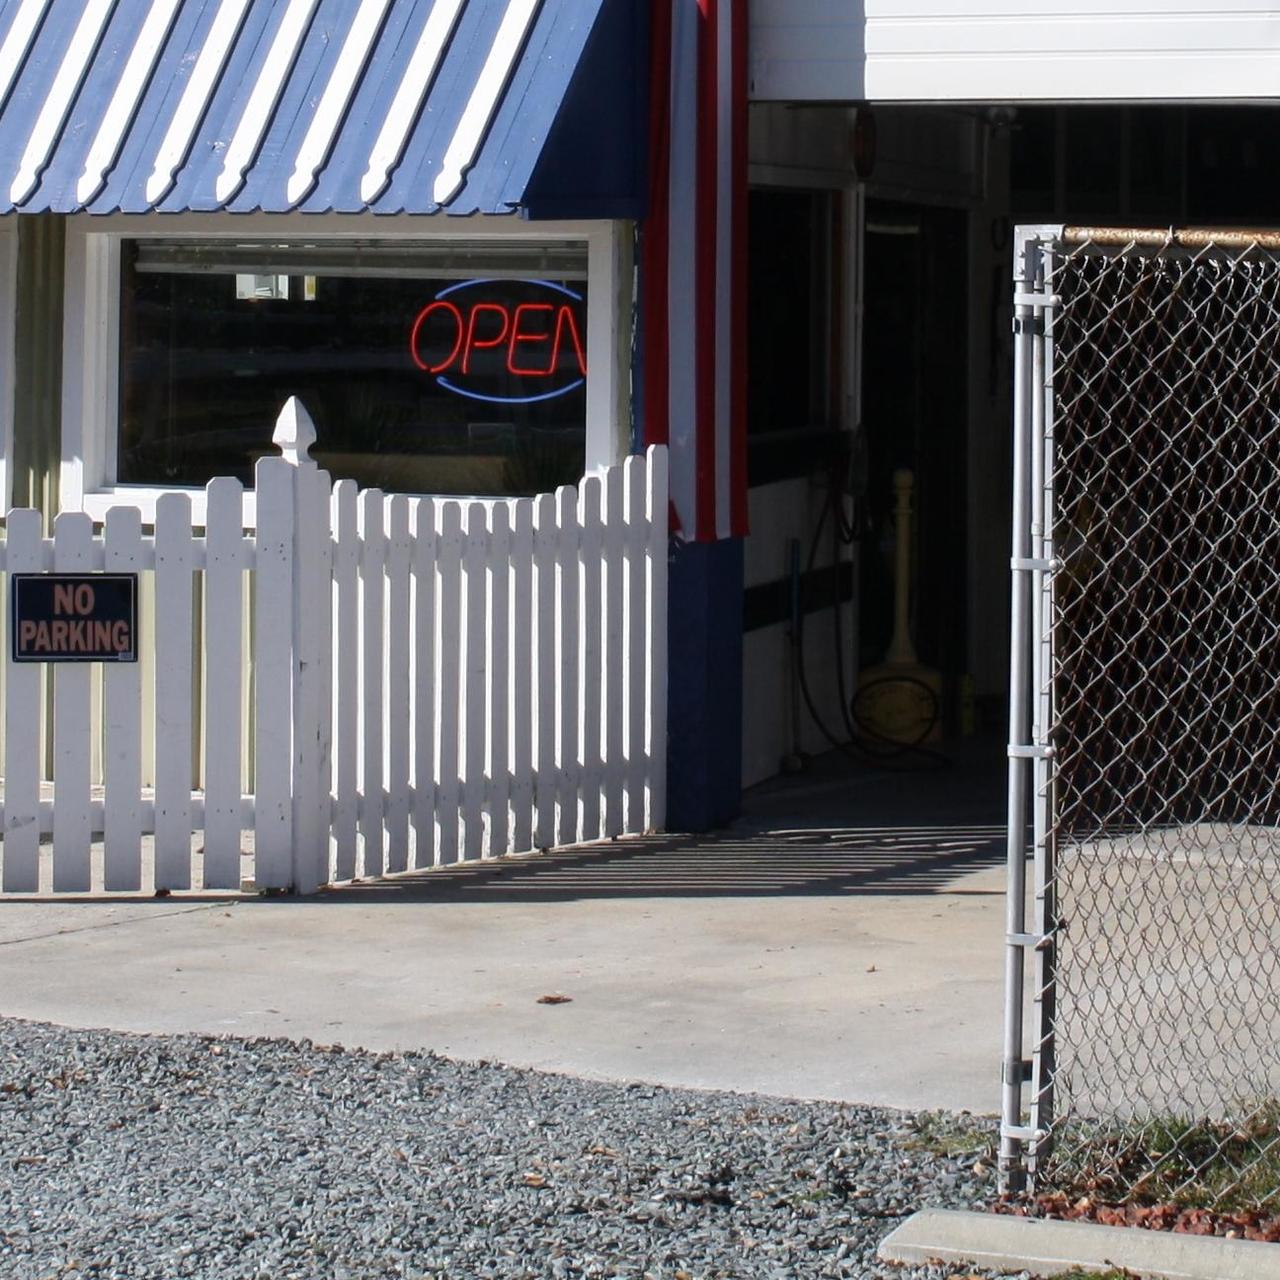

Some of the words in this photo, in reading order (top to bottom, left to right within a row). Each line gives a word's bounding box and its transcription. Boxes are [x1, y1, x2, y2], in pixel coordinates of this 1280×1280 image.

[411, 300, 587, 376] OPEN
[54, 583, 95, 615] NO
[20, 620, 129, 652] PARKING
